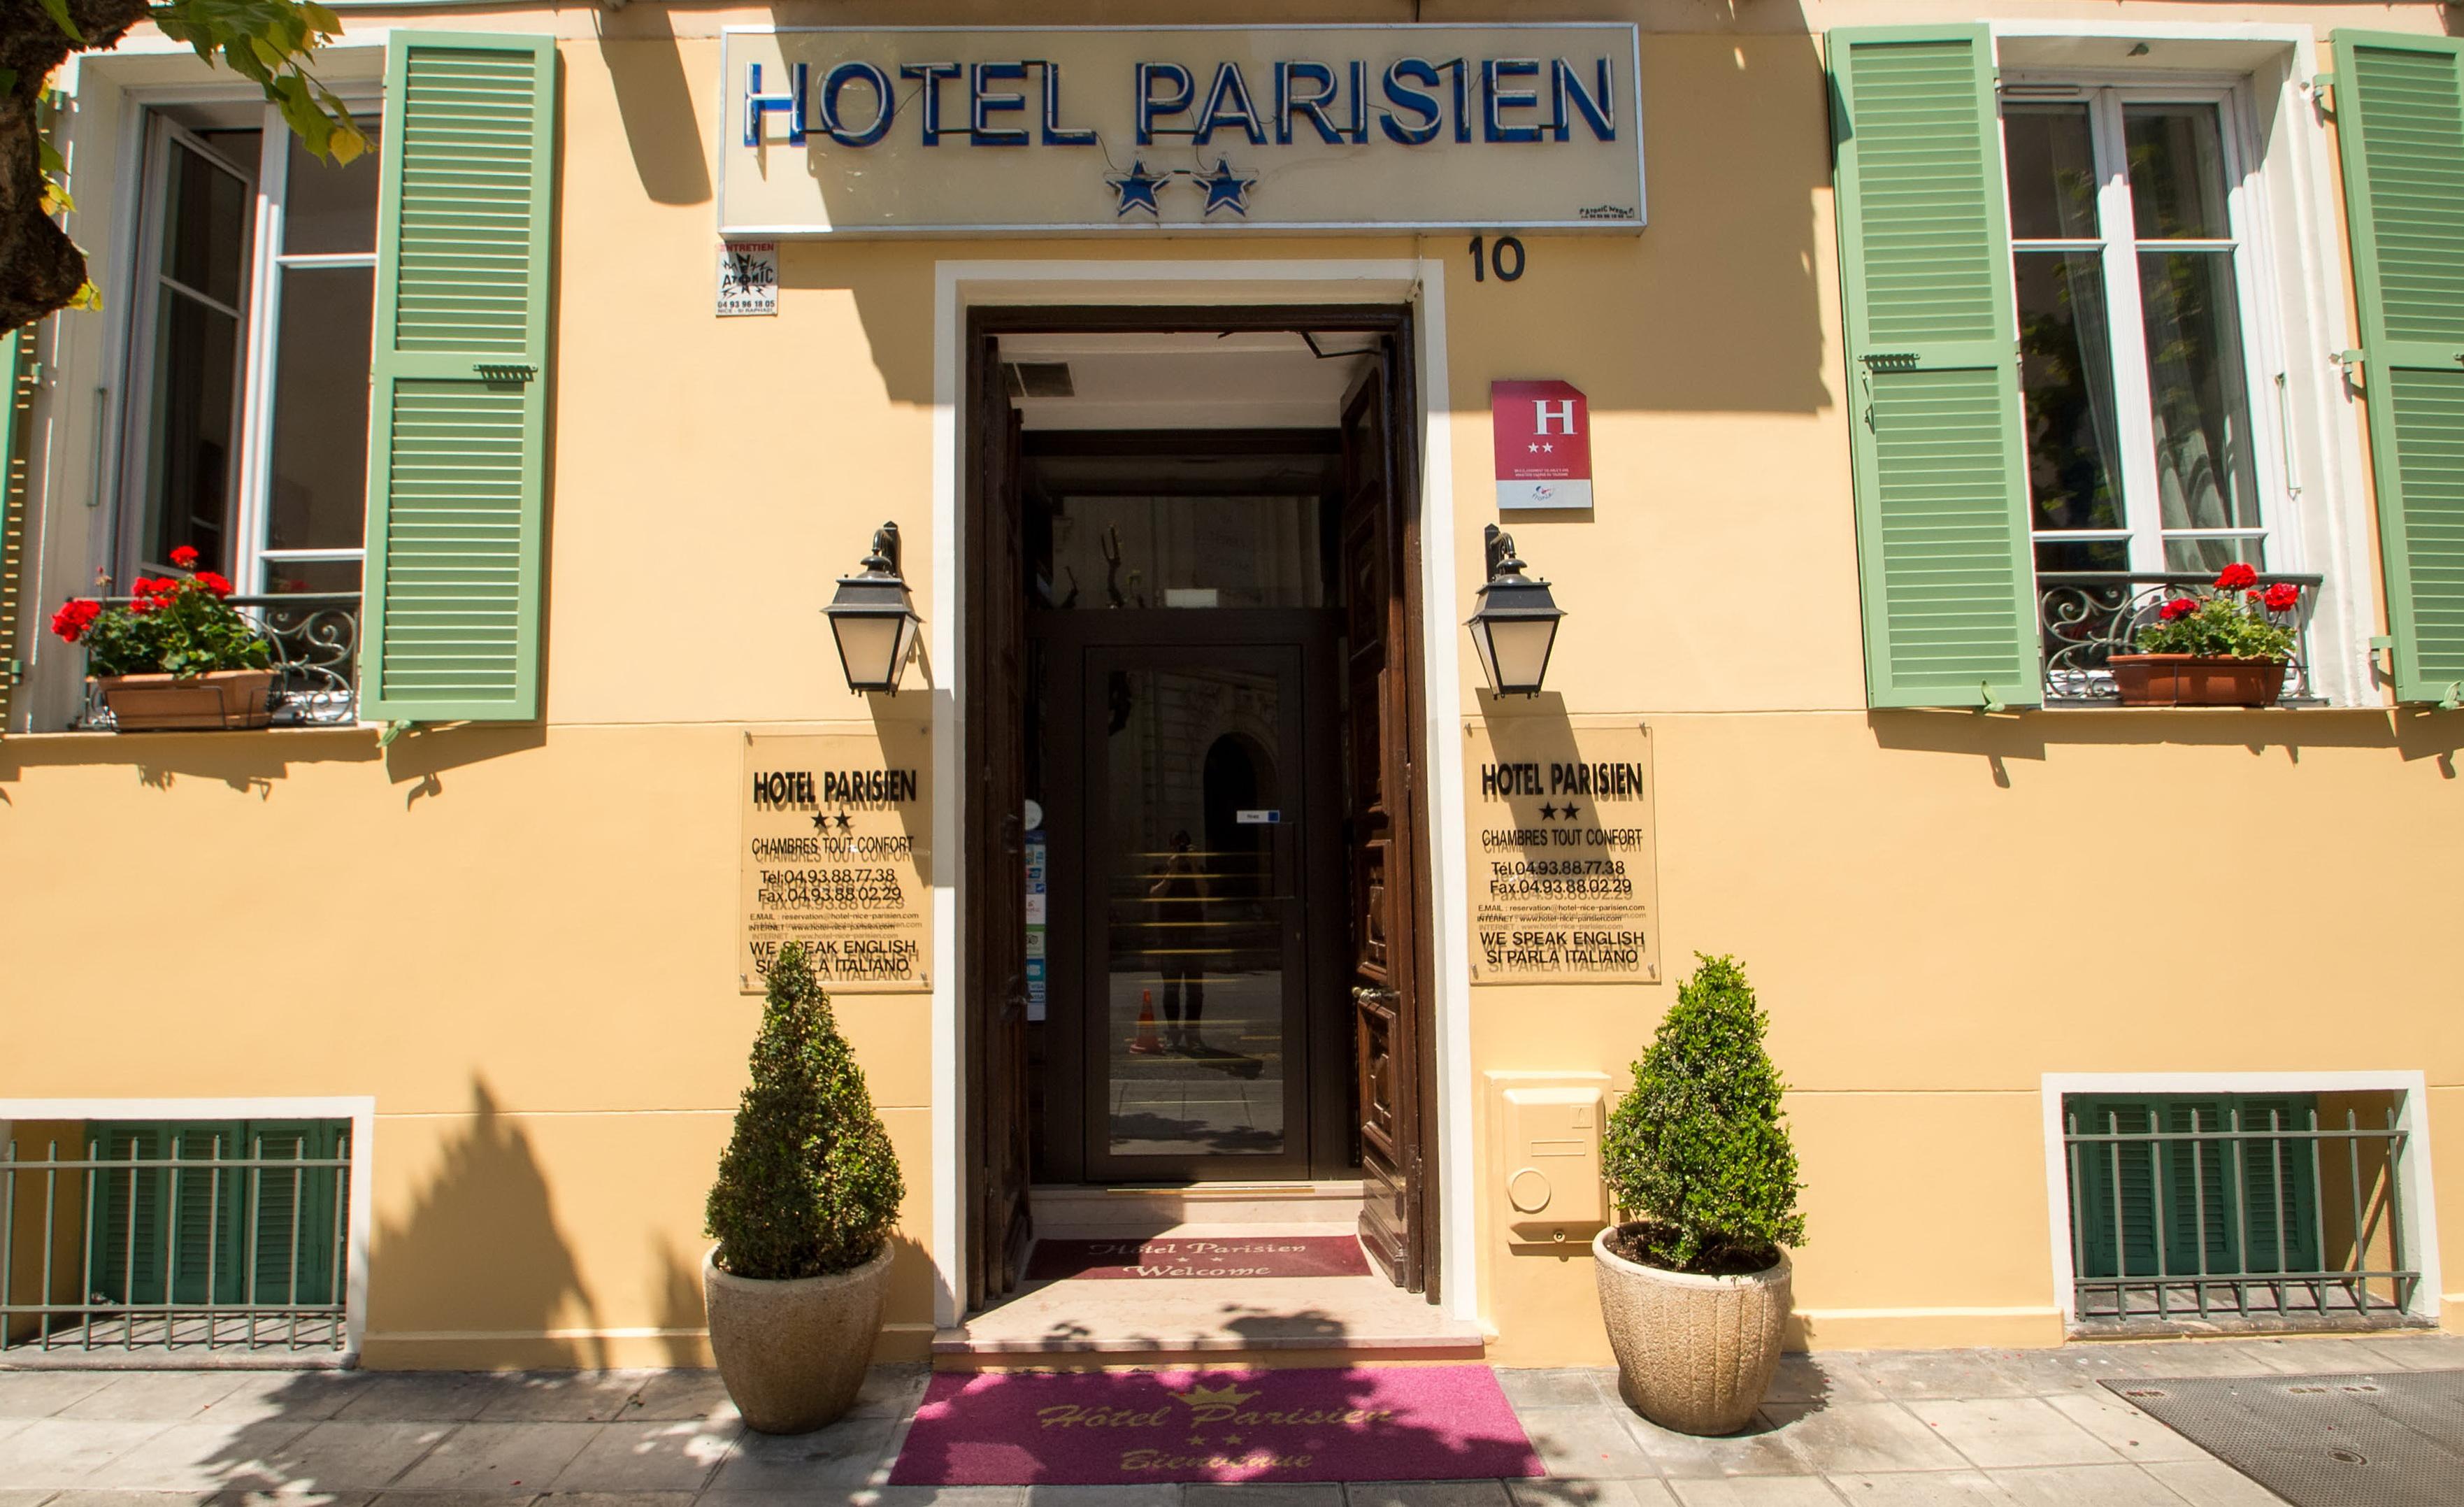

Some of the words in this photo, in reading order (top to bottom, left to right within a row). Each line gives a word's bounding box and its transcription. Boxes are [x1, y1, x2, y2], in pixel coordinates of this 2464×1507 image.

[744, 60, 1096, 147] HOTEL
[1136, 54, 1616, 146] PARISIEN
[720, 243, 774, 252] ENTRETIEN
[1469, 236, 1525, 282] 10
[1532, 399, 1578, 435] H
[754, 771, 816, 804] HOTEL
[824, 770, 917, 802] PARISIEN
[1482, 763, 1544, 796] HOTEL
[1551, 762, 1642, 795] PARISIEN
[752, 838, 818, 855] CHAMBRES
[824, 838, 854, 853] TOUT
[857, 836, 915, 853] CONFORT
[1482, 829, 1547, 846] CHAMBRES
[1553, 829, 1582, 845] TOUT
[1586, 828, 1642, 845] CONFORT
[1491, 861, 1625, 875] Tél.04.93.88.77.38
[1490, 879, 1631, 893] Fax.04.93.88.02.29
[1480, 932, 1507, 945] WE
[1512, 931, 1567, 945] SPEAK
[1573, 931, 1644, 945] ENGLISH
[750, 941, 776, 955] WE
[844, 939, 916, 953] ENGLISH
[836, 958, 909, 972] ITALIANO
[1487, 950, 1502, 964] SI
[1507, 950, 1560, 963] PARLA
[1566, 949, 1638, 964] ITALIANO
[1187, 1241, 1307, 1255] Parisien
[1122, 1264, 1272, 1277] Welcome
[1036, 1404, 1172, 1428] Hôtel
[1188, 1404, 1395, 1429] Parisien
[1120, 1449, 1315, 1471] Bienvenue
